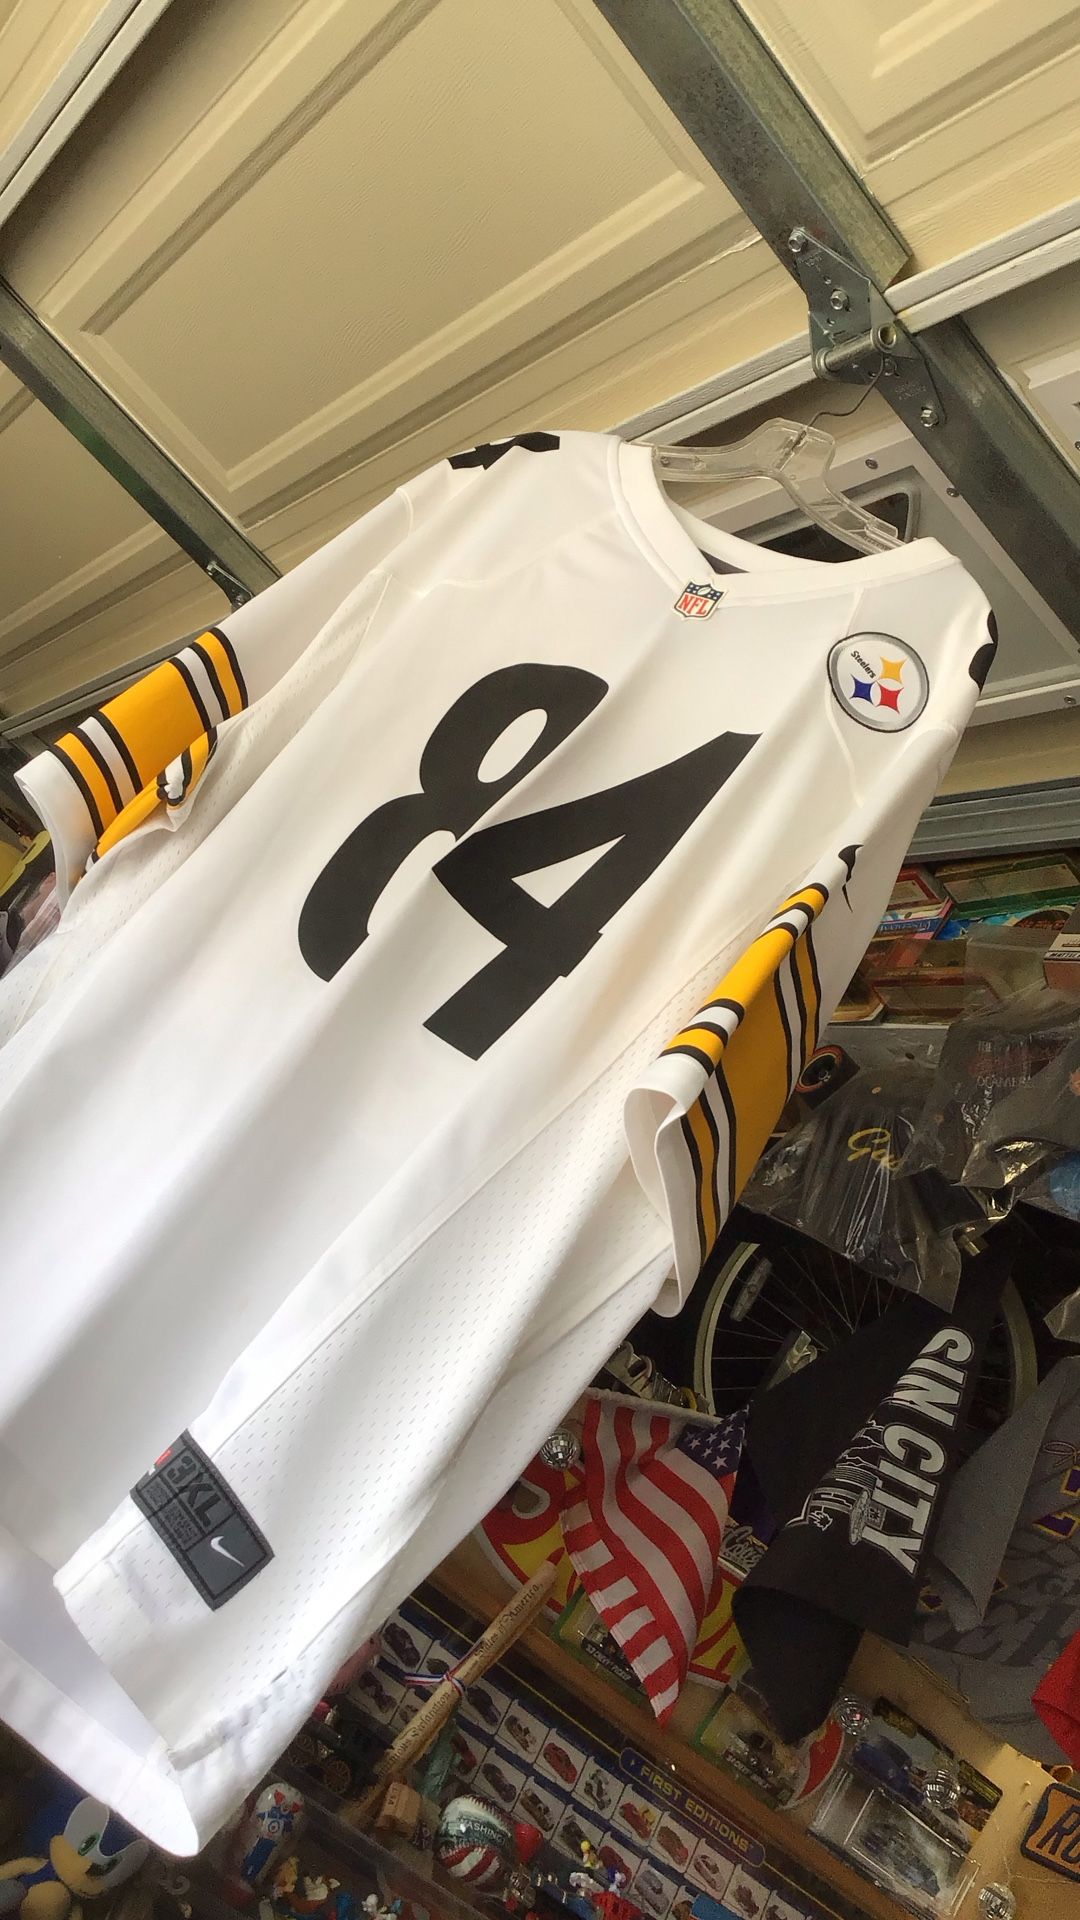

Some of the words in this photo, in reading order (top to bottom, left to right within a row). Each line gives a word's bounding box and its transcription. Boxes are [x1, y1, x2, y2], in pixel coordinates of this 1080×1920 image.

[678, 594, 710, 615] NFL
[851, 650, 877, 679] Steelers
[298, 663, 763, 1061] 84
[891, 1328, 974, 1427] SIN
[166, 1455, 222, 1528] 3XL
[862, 1424, 946, 1575] CITY
[641, 1765, 682, 1801] FIRST
[684, 1797, 750, 1853] EDITIONS
